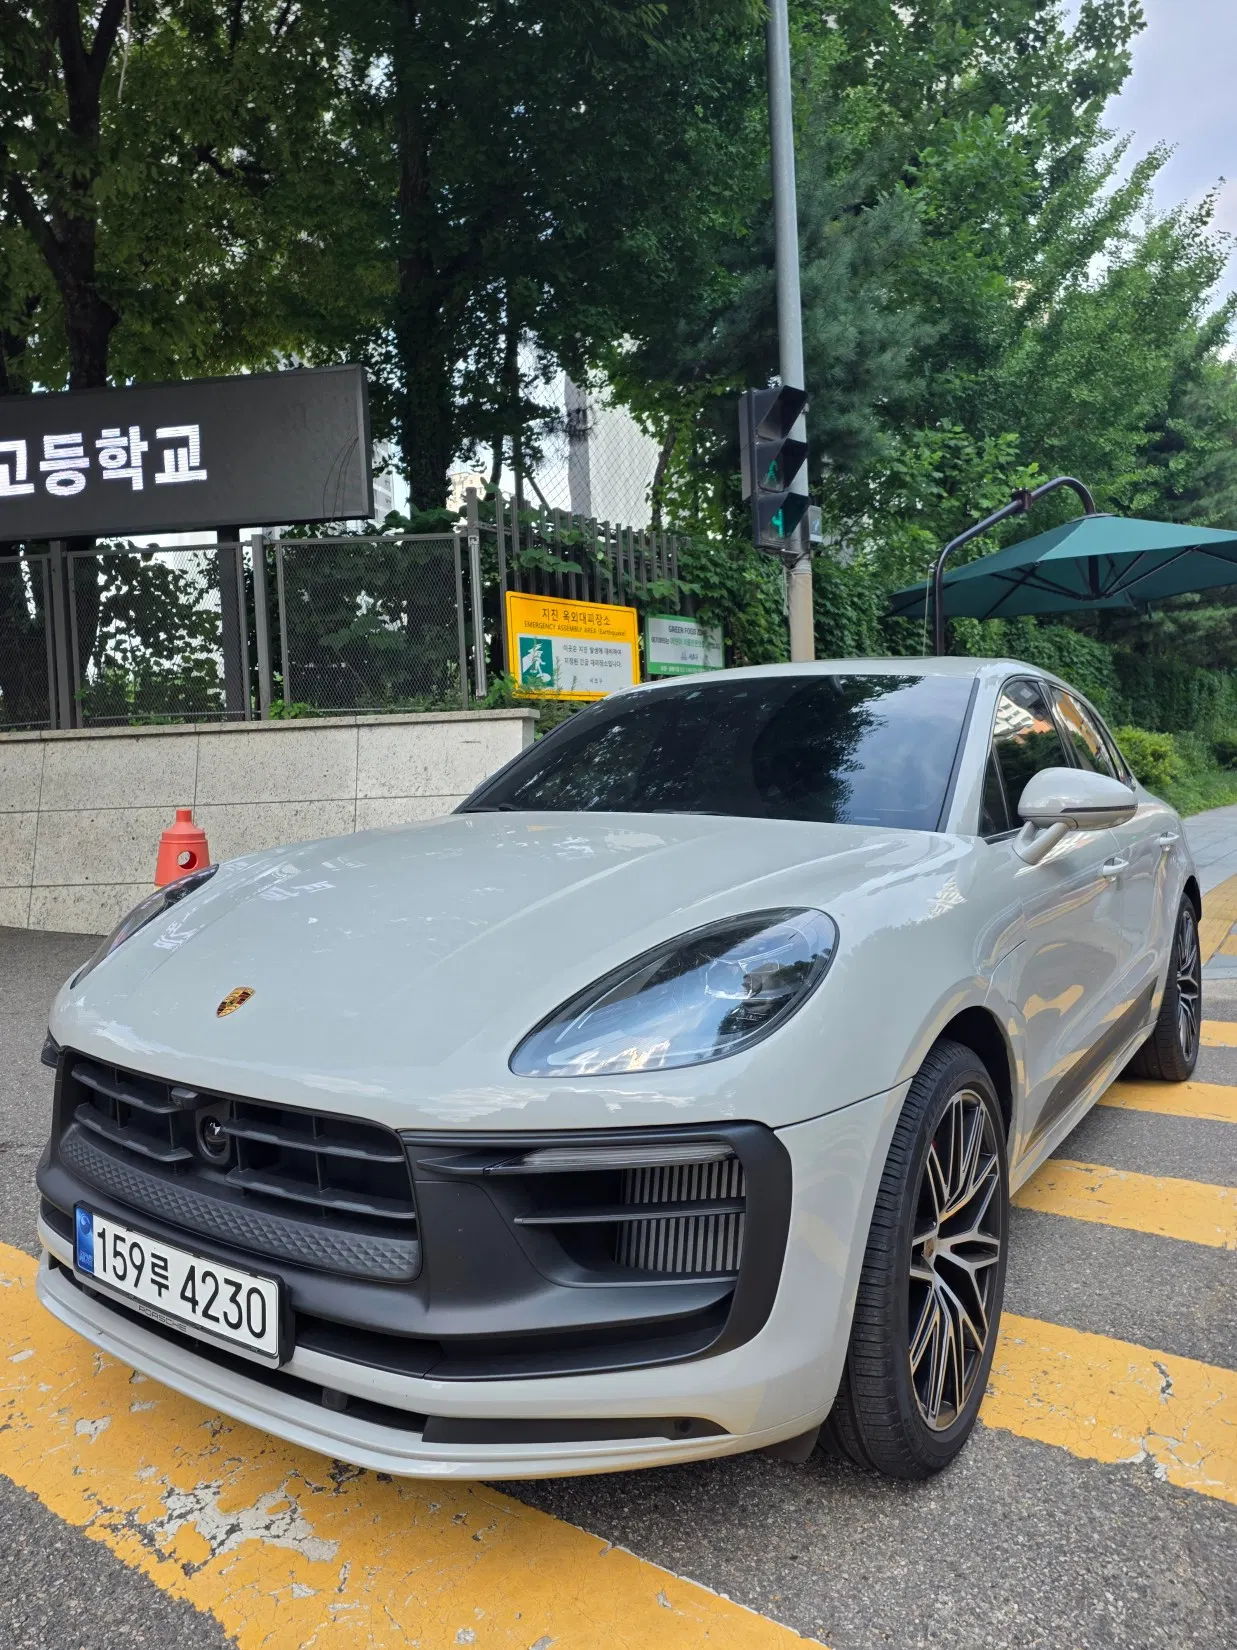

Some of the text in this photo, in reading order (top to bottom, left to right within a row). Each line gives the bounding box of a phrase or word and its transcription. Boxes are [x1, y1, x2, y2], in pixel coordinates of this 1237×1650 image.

[0, 425, 207, 497] 고등학교
[542, 608, 611, 626] 지진 옥외대피장소
[524, 620, 556, 630] EMERGENCY
[557, 624, 582, 633] ASSEMBLY
[584, 627, 597, 635] AREA
[668, 625, 684, 634] GREEN
[684, 627, 697, 636] FOOD
[563, 644, 577, 653] 이곳은
[579, 646, 588, 654] 지진
[604, 648, 622, 656] 대비하여
[564, 657, 579, 666] 지정된
[580, 658, 589, 667] 긴급
[97, 1227, 266, 1338] 159루 4230
[138, 1305, 187, 1332] PORSCHE
